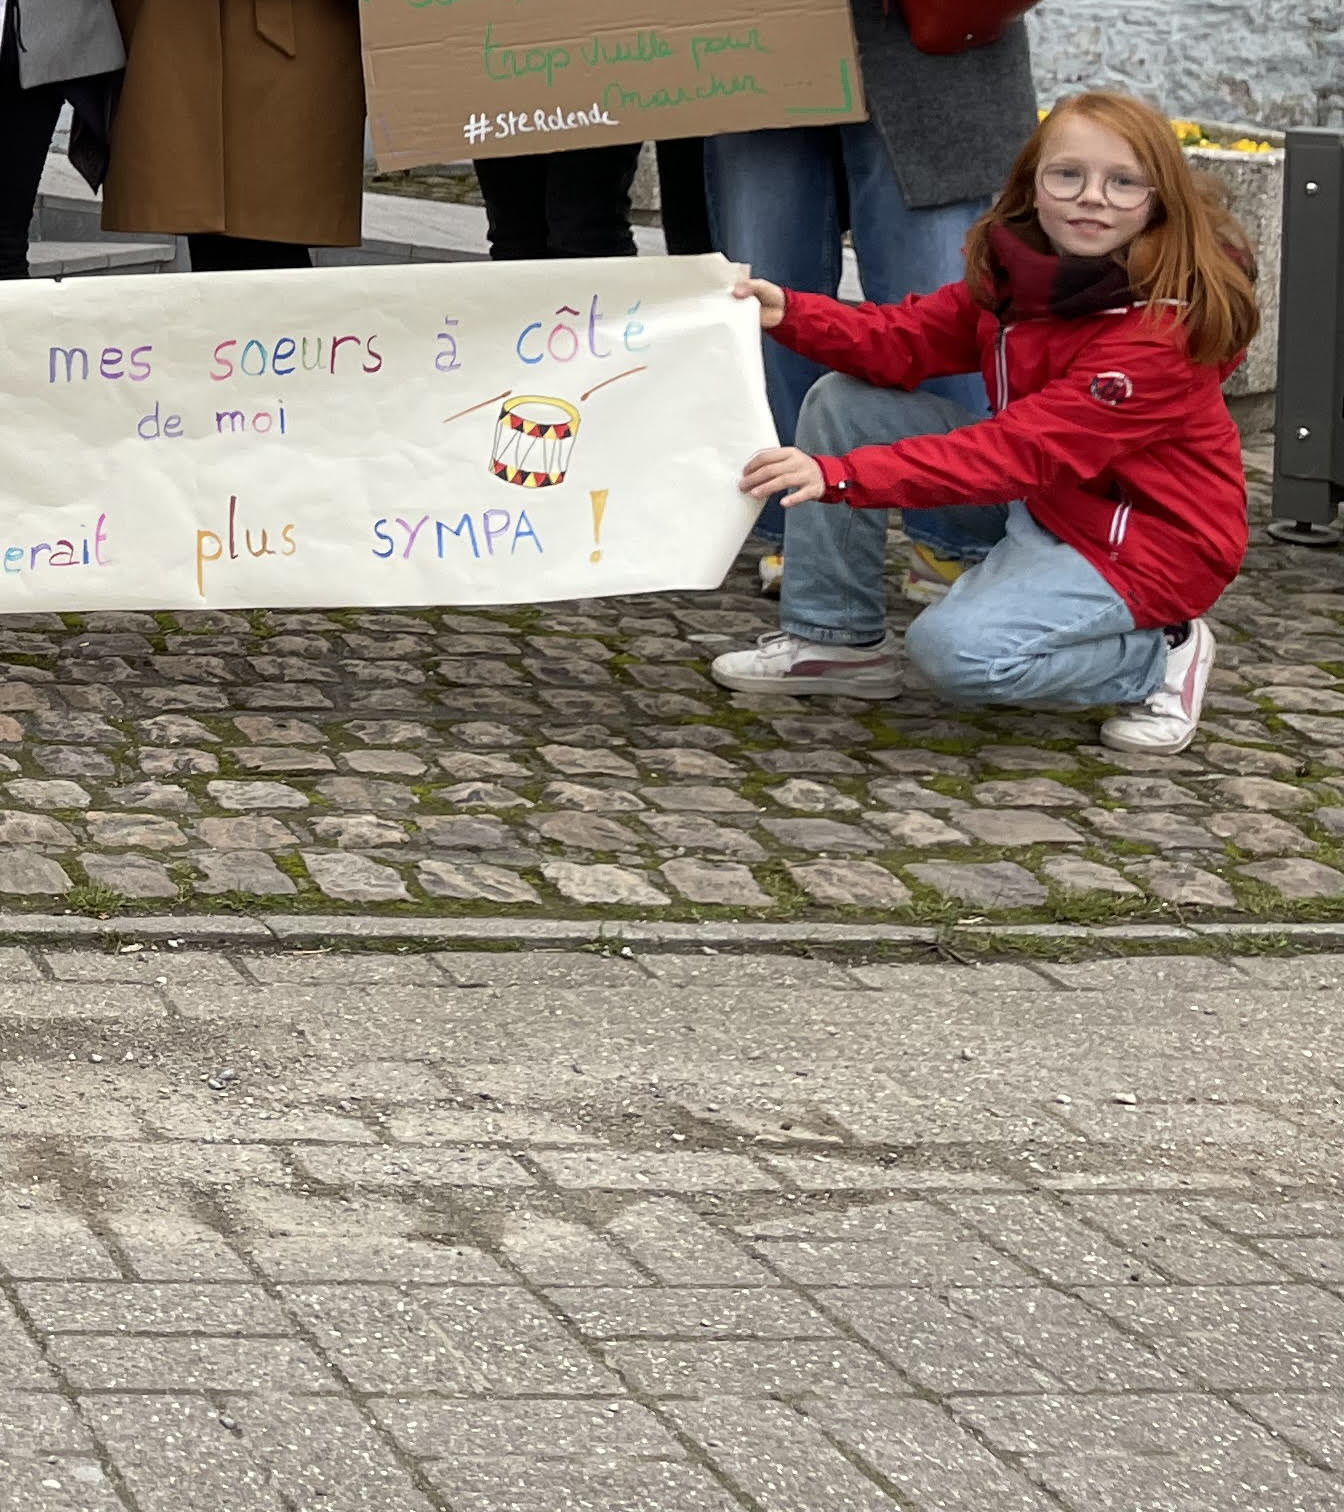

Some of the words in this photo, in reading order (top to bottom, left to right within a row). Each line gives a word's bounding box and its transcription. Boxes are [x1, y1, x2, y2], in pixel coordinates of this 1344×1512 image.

[481, 23, 570, 88] trop
[48, 343, 154, 384] mes
[209, 330, 384, 381] soeurs
[515, 293, 652, 365] côté
[137, 399, 185, 440] de
[215, 402, 288, 436] moi
[196, 495, 297, 600] plus
[372, 509, 544, 561] SYMPA
